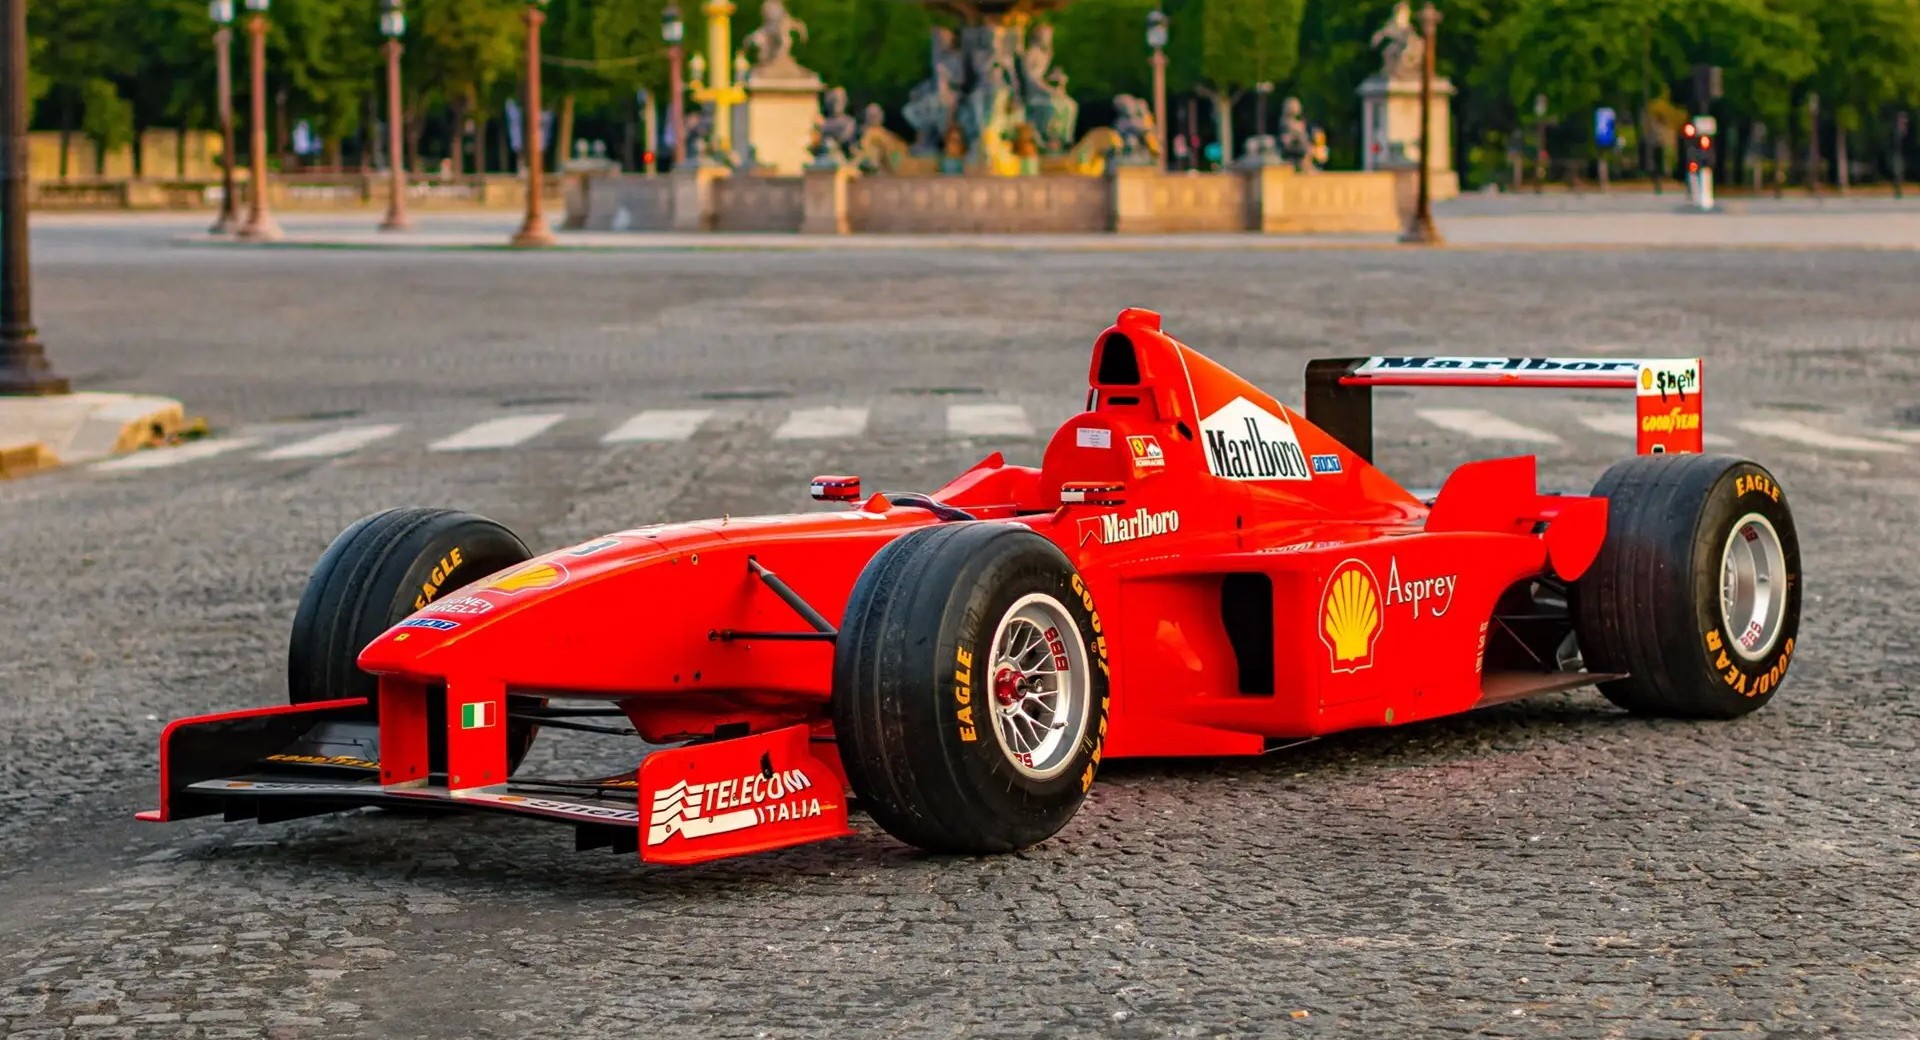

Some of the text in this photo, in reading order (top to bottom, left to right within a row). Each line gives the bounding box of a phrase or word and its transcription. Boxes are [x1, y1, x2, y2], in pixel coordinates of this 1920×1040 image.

[1206, 417, 1308, 478] Marlboro
[1313, 456, 1340, 472] FIAT
[1736, 474, 1780, 502] EAGLE
[1101, 507, 1179, 544] Marlboro
[415, 547, 463, 610] EAGLE
[1386, 555, 1457, 619] Asprey
[1043, 626, 1070, 671] BBS
[955, 645, 977, 743] EAGLE
[705, 768, 813, 812] TELECOM
[760, 798, 821, 824] ITALIA
